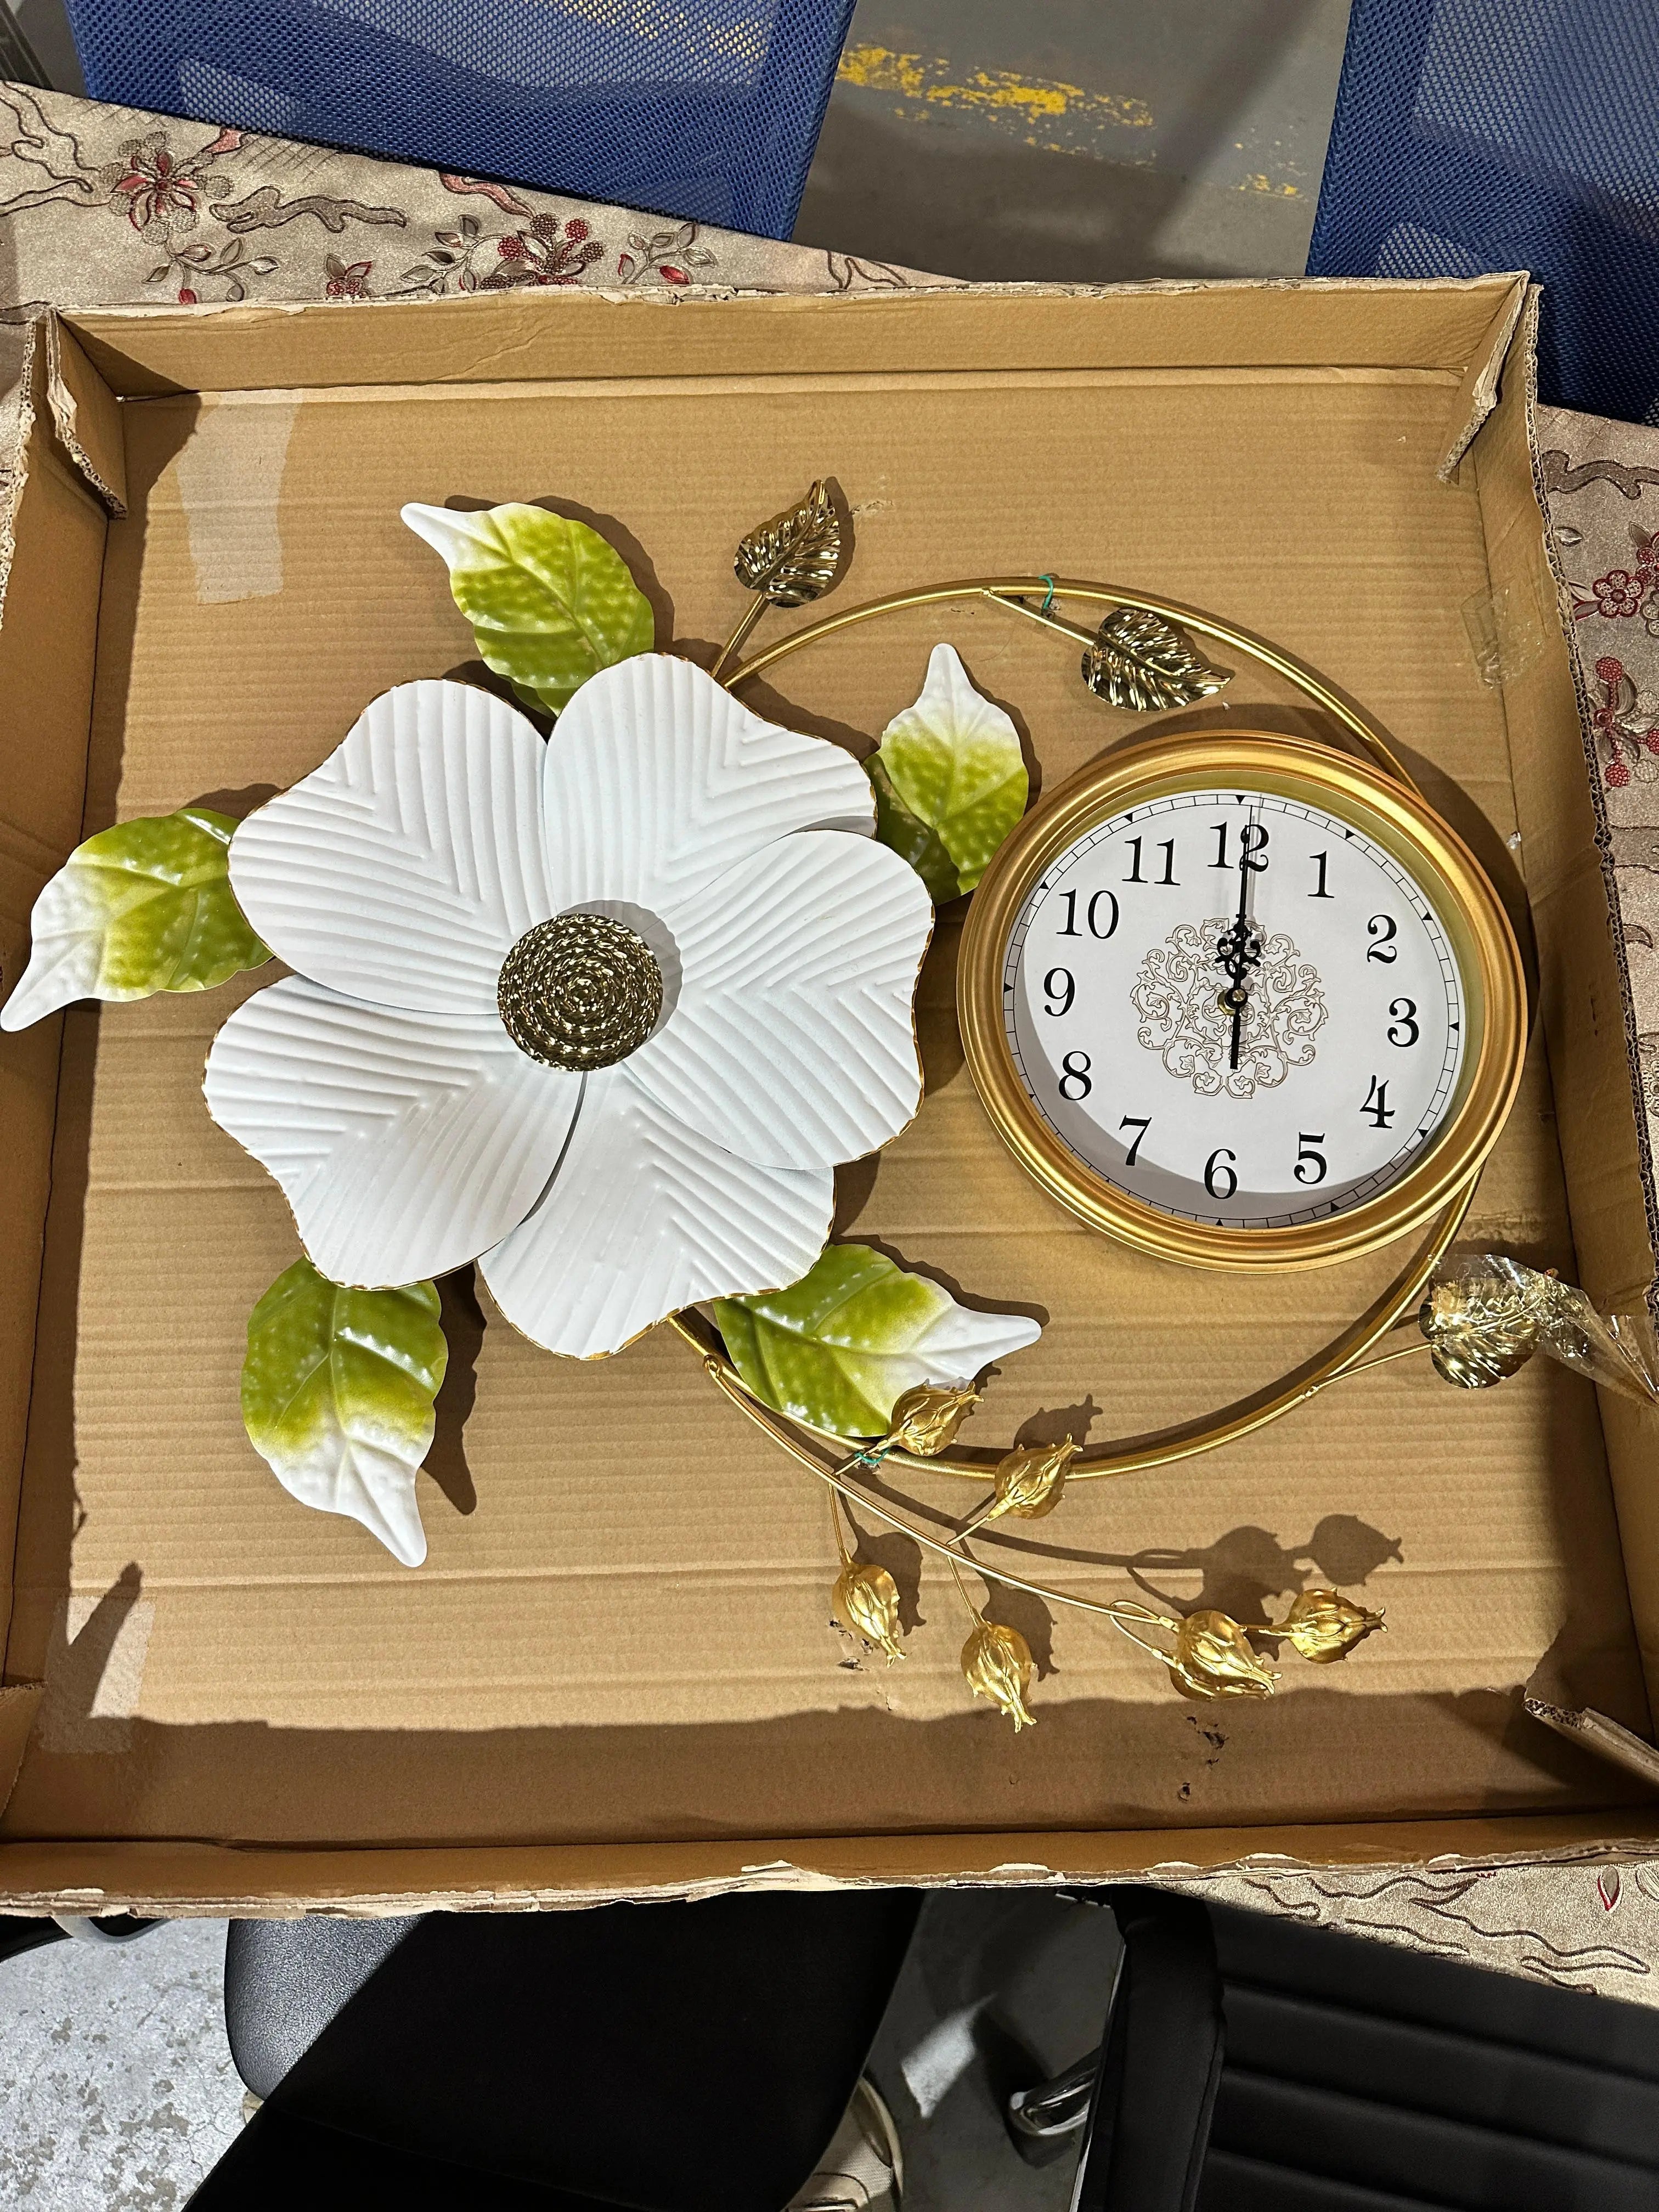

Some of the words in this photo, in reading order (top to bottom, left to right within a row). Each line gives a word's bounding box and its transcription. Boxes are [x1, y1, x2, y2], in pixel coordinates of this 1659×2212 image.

[1121, 836, 1181, 886] 11
[1207, 821, 1269, 873] 12
[1307, 850, 1335, 899] 1
[1056, 888, 1119, 939] 10
[1367, 914, 1397, 964] 2
[1043, 967, 1075, 1017] 9
[1387, 997, 1419, 1048] 3
[1058, 1051, 1092, 1101] 8
[1359, 1075, 1396, 1129] 4
[1119, 1114, 1152, 1166] 7
[1294, 1131, 1327, 1184] 5
[1204, 1148, 1238, 1200] 6
